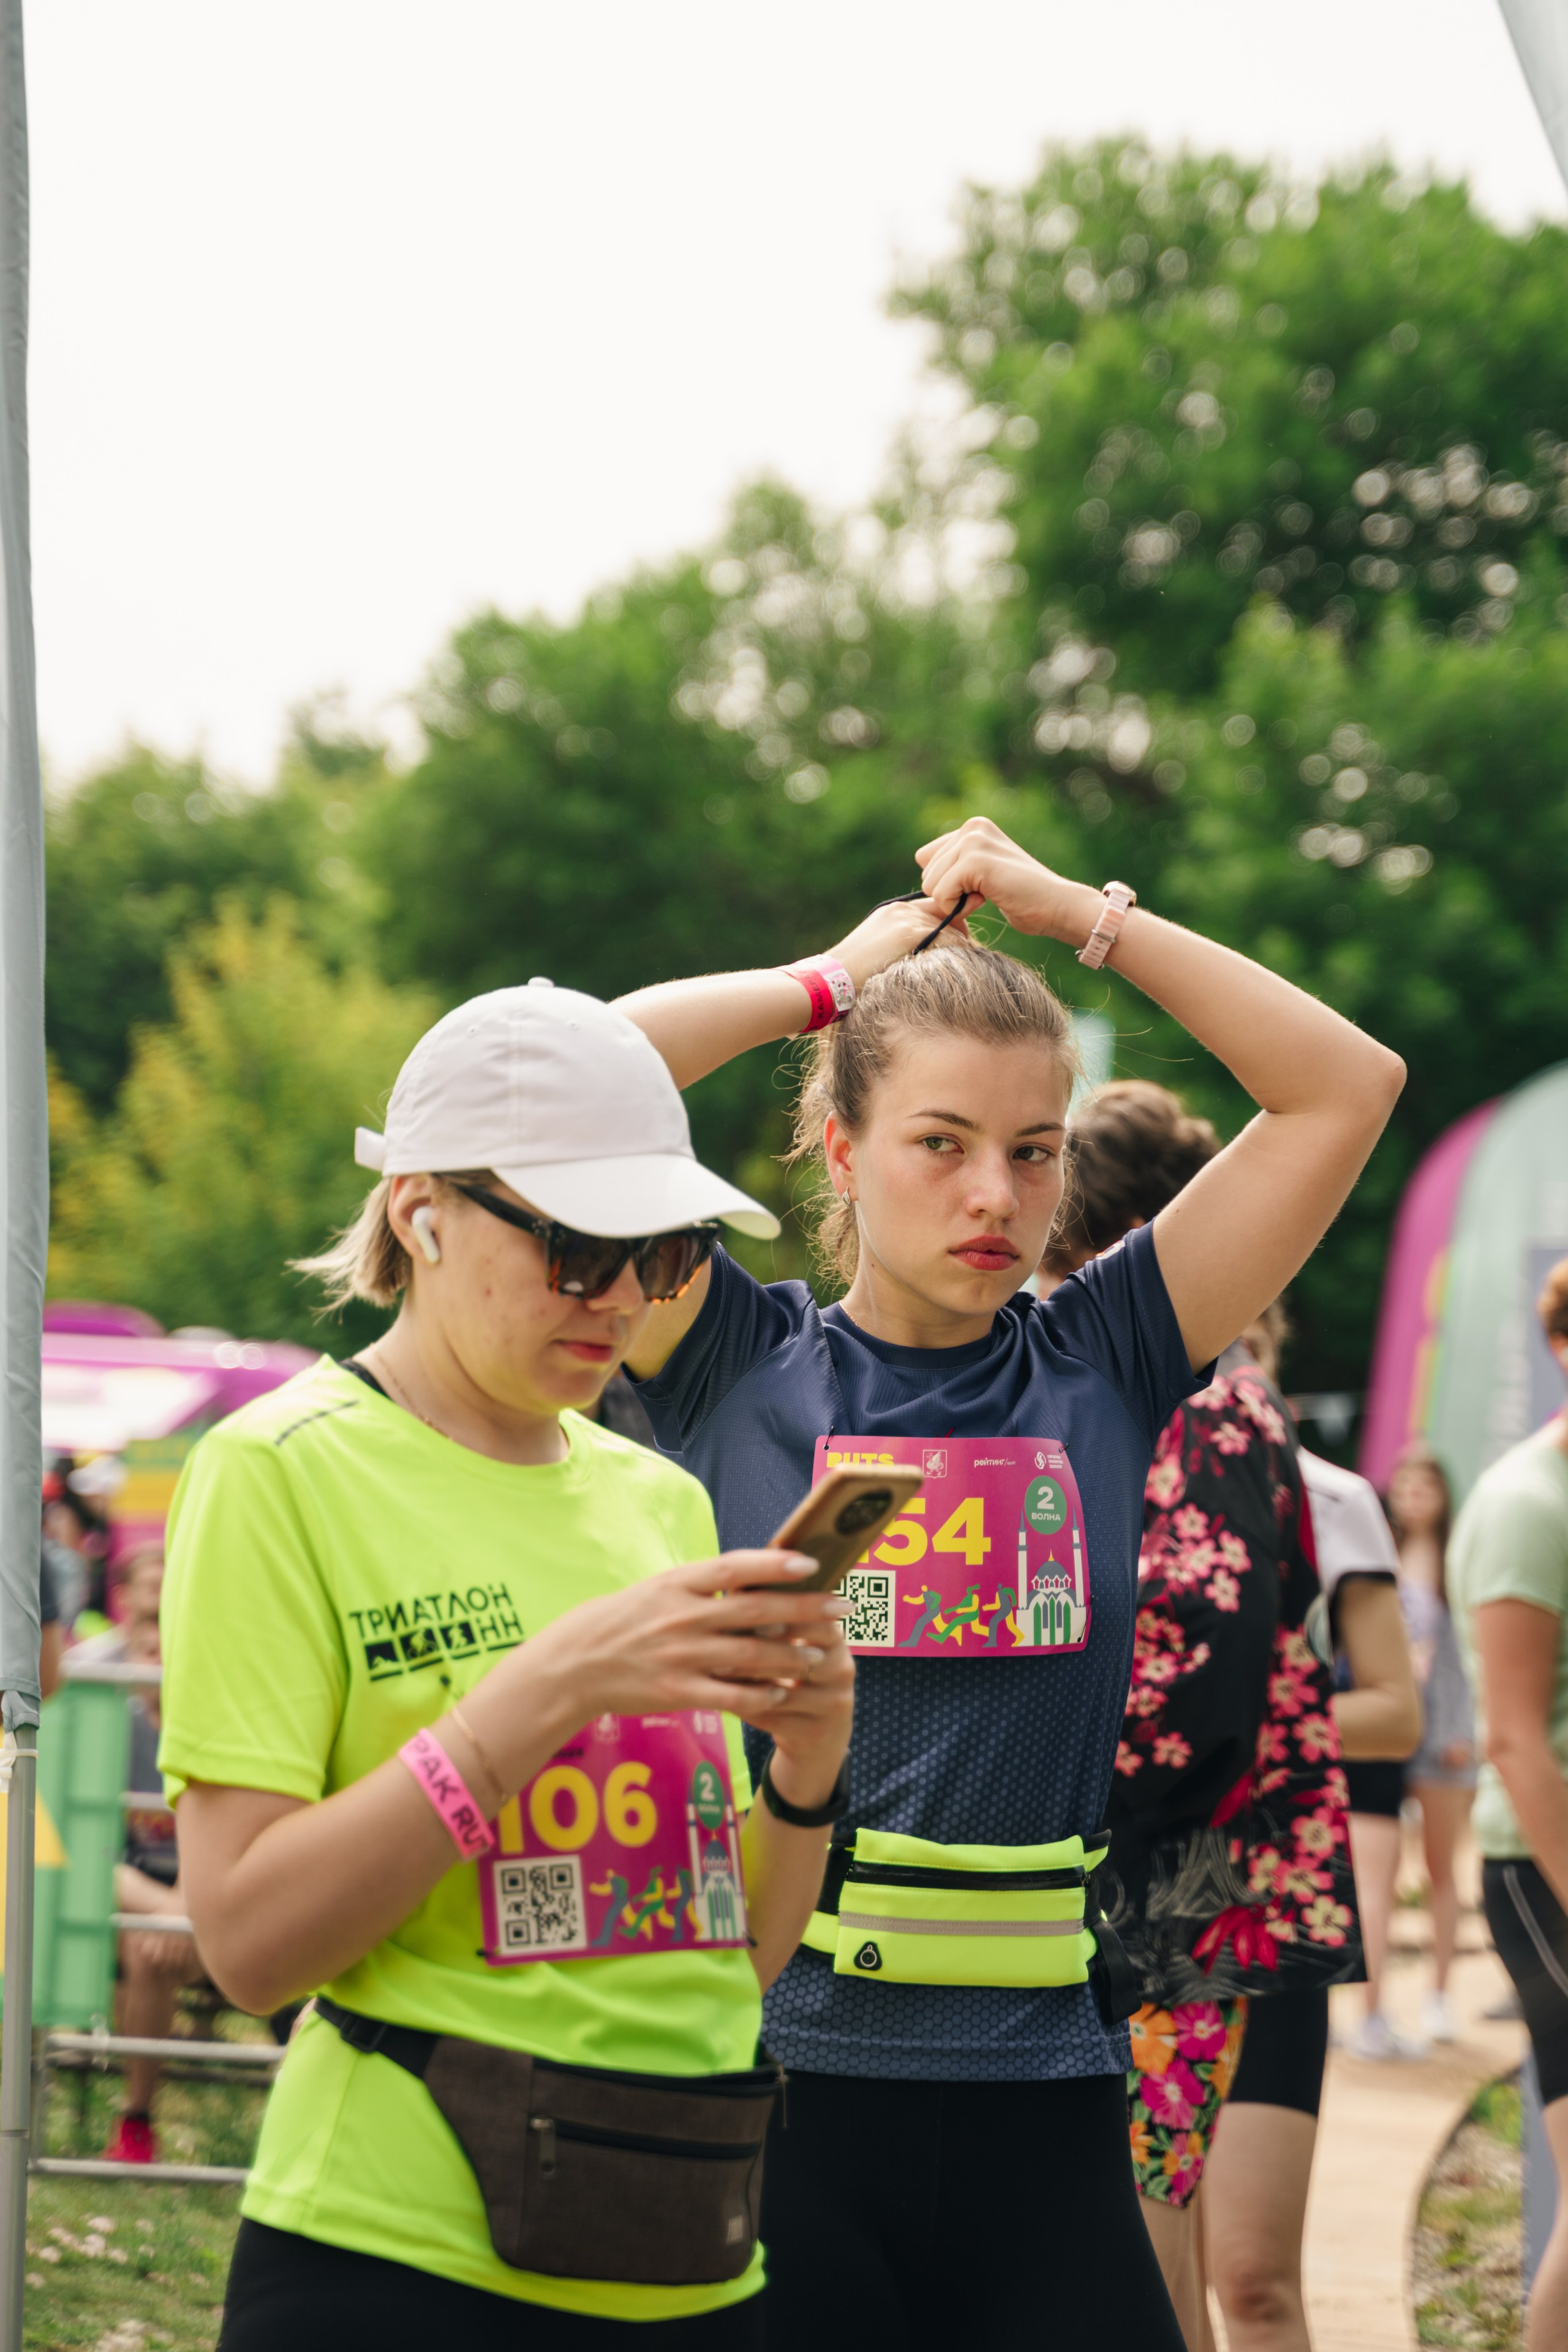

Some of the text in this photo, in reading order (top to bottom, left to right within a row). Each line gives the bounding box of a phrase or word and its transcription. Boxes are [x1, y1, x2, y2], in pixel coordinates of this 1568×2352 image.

[1031, 1512, 1061, 1521] ВОЛНА
[1037, 1486, 1055, 1510] 2
[858, 1498, 991, 1566] 54
[349, 1582, 513, 1639] ТРИАТЛОН
[498, 1761, 658, 1855] 106
[699, 1772, 715, 1801] 2
